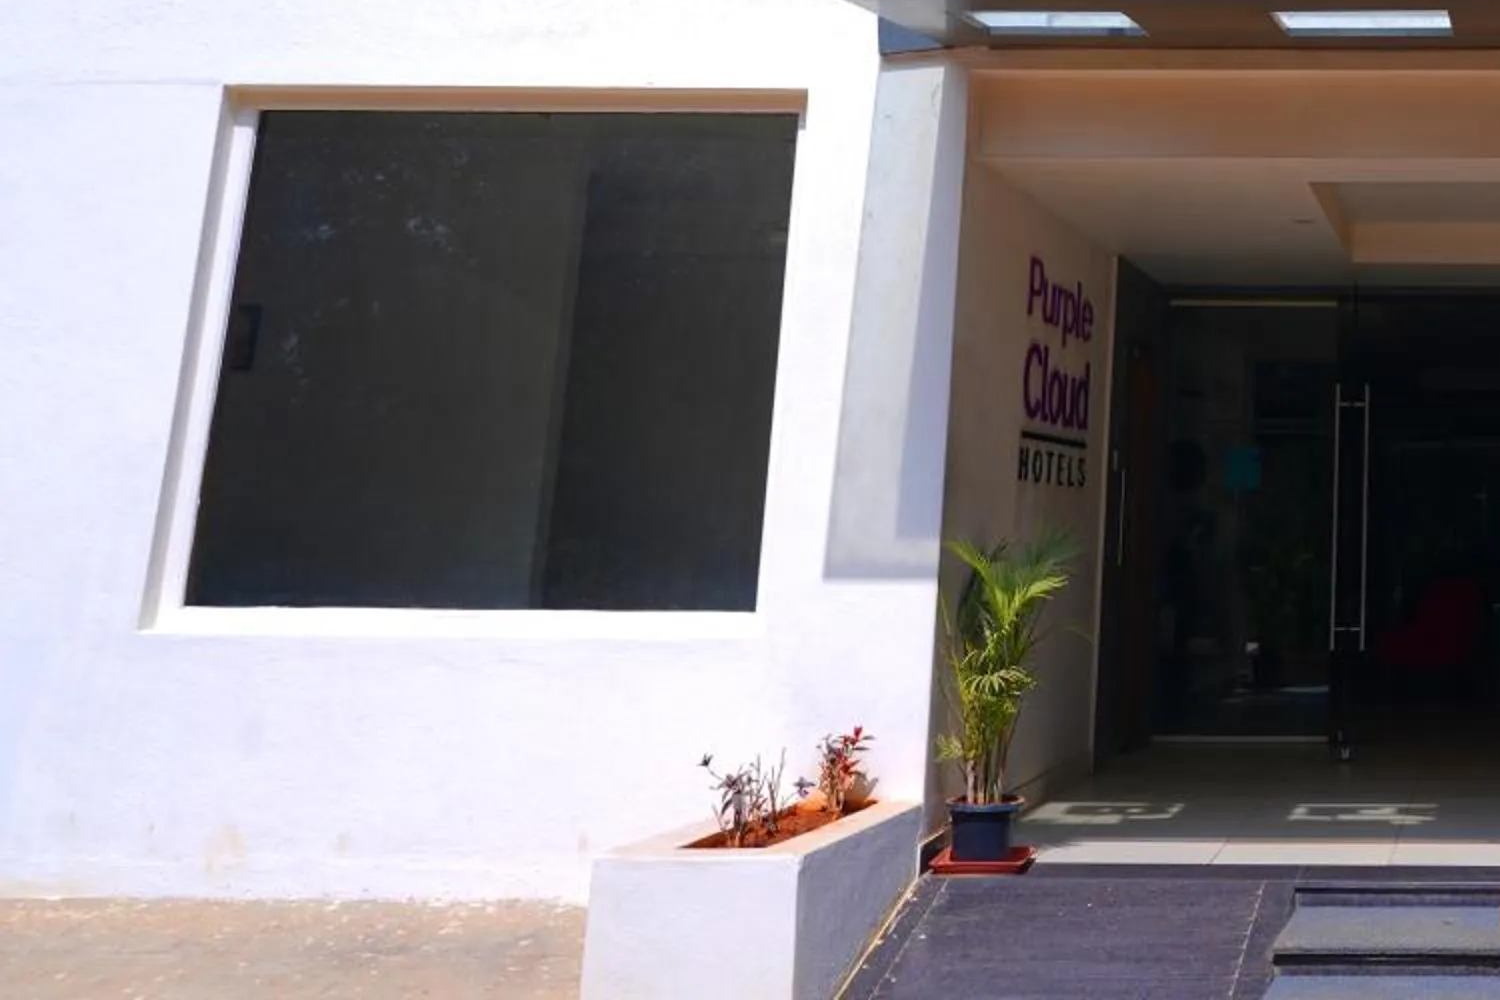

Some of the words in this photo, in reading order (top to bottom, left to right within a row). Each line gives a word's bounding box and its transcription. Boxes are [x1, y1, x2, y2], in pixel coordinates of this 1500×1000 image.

[1026, 256, 1094, 348] Purple
[1022, 343, 1091, 431] Cloud
[1016, 446, 1087, 488] HOTELS
